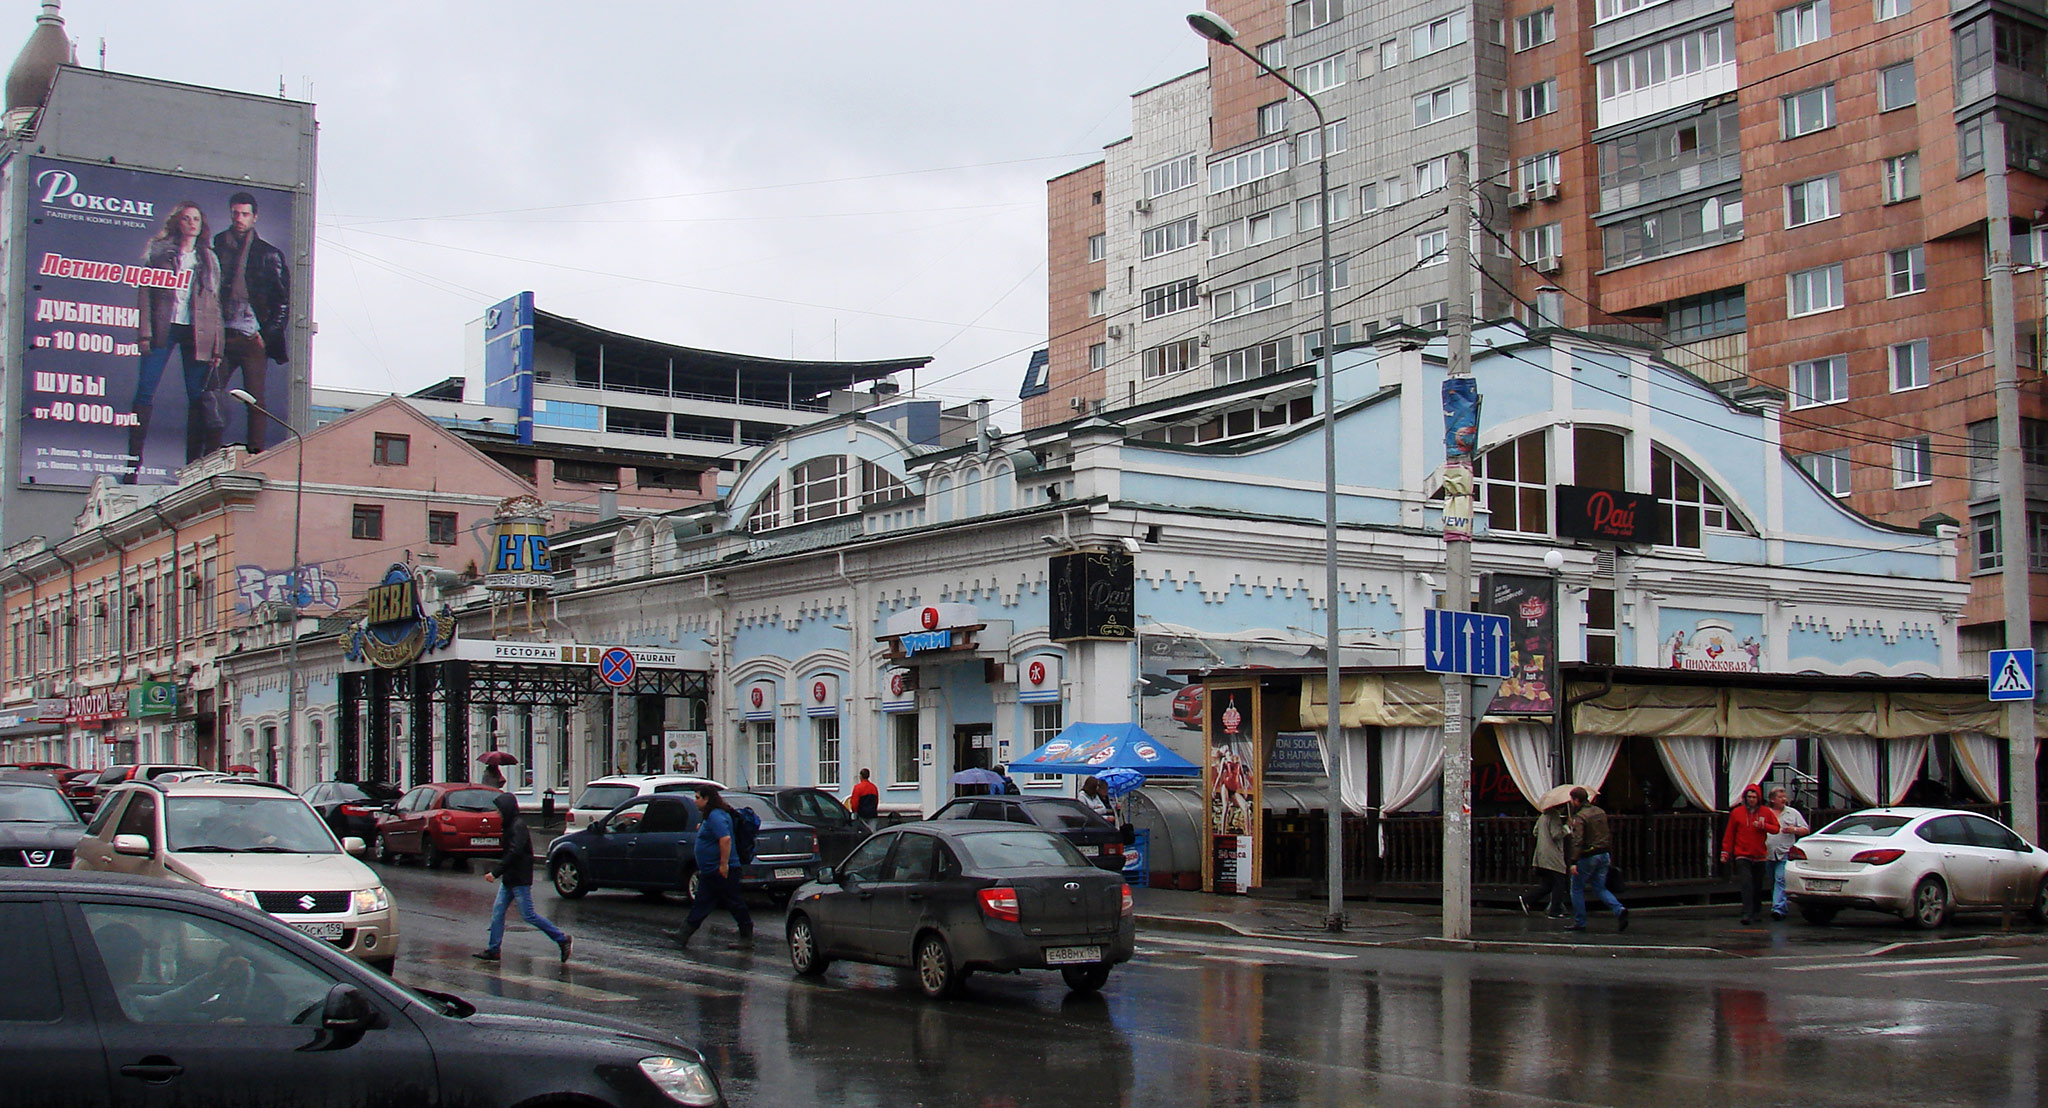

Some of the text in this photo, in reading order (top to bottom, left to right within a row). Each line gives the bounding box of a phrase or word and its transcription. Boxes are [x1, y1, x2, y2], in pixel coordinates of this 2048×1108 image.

[37, 169, 154, 216] РОКСАН
[46, 210, 84, 221] ГАЛЕРЕЯ
[86, 216, 112, 225] КОЖИ
[123, 221, 146, 229] МЕХА
[40, 253, 193, 290] Летние цены!
[37, 299, 140, 328] ДУБЛЕНКИ
[36, 331, 142, 356] от 10 000 руб.
[36, 371, 106, 397] ШУБЫ
[35, 401, 141, 427] от 40 000 руб.
[1587, 491, 1637, 531] Рай
[368, 582, 413, 623] НЕВА
[496, 646, 604, 664] РЕСТОРАН НЕВ
[1685, 659, 1747, 672] ПИРОЖКОВАЯ
[326, 923, 341, 932] 159
